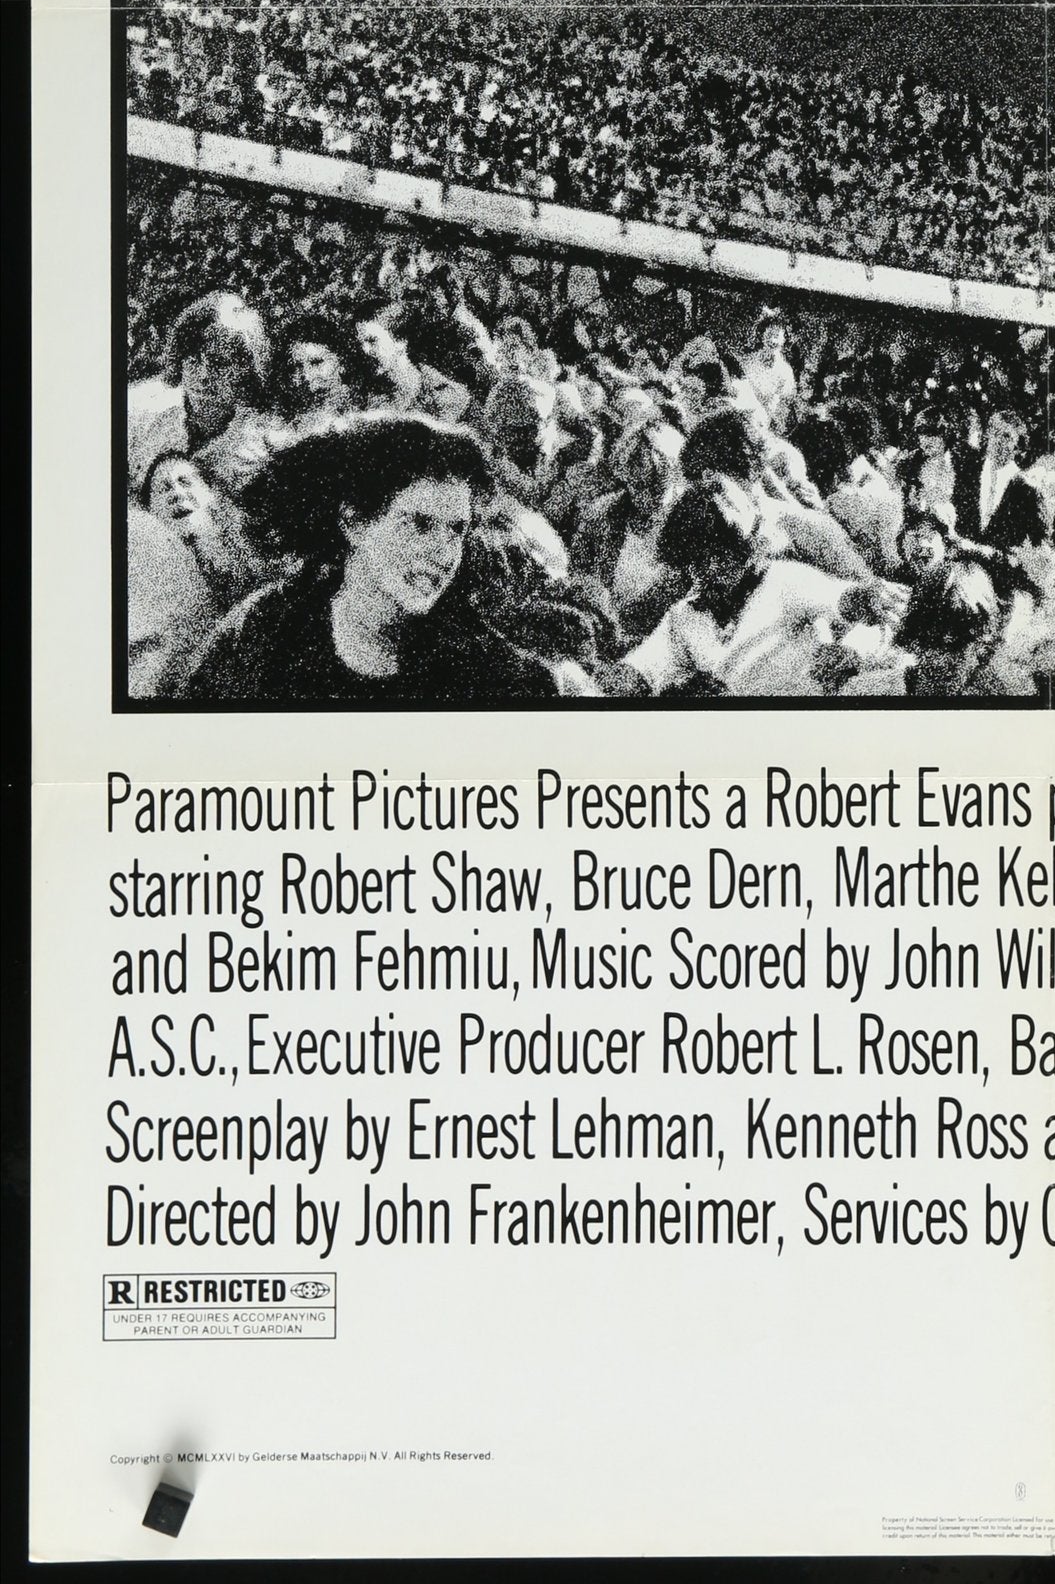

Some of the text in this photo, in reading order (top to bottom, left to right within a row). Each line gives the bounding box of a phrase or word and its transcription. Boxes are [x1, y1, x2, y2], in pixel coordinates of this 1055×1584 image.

[108, 772, 334, 833] Paramount
[353, 769, 518, 830] Pictures
[538, 769, 710, 829] Presents
[726, 785, 746, 829] a
[767, 767, 900, 828] Robert
[919, 767, 1031, 828] Evans
[110, 854, 263, 928] starring
[283, 853, 416, 914] Robert
[432, 850, 551, 922] Shaw,
[574, 850, 690, 910] Bruce
[710, 848, 812, 919] Dern,
[836, 845, 978, 908] Marthe
[113, 933, 186, 995] and
[209, 930, 335, 992] Bekim
[356, 929, 519, 1001] Fehmiu,
[533, 928, 652, 989] Music
[670, 927, 805, 989] Scored
[827, 927, 869, 1002] by
[885, 927, 978, 990] John
[109, 1014, 237, 1086] A.S.C.,
[249, 1013, 440, 1075] Executive
[461, 1013, 645, 1074] Producer
[663, 1012, 797, 1074] Robert
[814, 1014, 842, 1074] L.
[860, 1013, 988, 1086] Rosen,
[106, 1099, 328, 1174] Screenplay
[347, 1099, 390, 1174] by
[410, 1099, 535, 1159] Ernest
[553, 1097, 723, 1170] Lehman,
[748, 1097, 916, 1159] Kenneth
[938, 1097, 1028, 1159] Ross
[108, 1184, 275, 1246] Directed
[297, 1184, 339, 1259] by
[355, 1183, 449, 1246] John
[471, 1182, 783, 1256] Frankenheimer,
[804, 1183, 967, 1245] Services
[986, 1183, 1028, 1259] by
[108, 1280, 286, 1304] R RESTRICTED
[113, 1312, 326, 1323] UNDER 17 REQUIRES ACCOMPANYING
[134, 1325, 302, 1335] PARENT OR ADULT GUARDIAN
[110, 1453, 160, 1466] Copyright
[177, 1453, 235, 1463] MCMLXXVI
[238, 1453, 250, 1464] by
[252, 1451, 298, 1462] Gelderse
[300, 1451, 367, 1464] Maatschappij
[369, 1451, 391, 1461] N.V.
[393, 1451, 407, 1461] All
[409, 1451, 441, 1463] Rights
[443, 1450, 494, 1461] Reserved.
